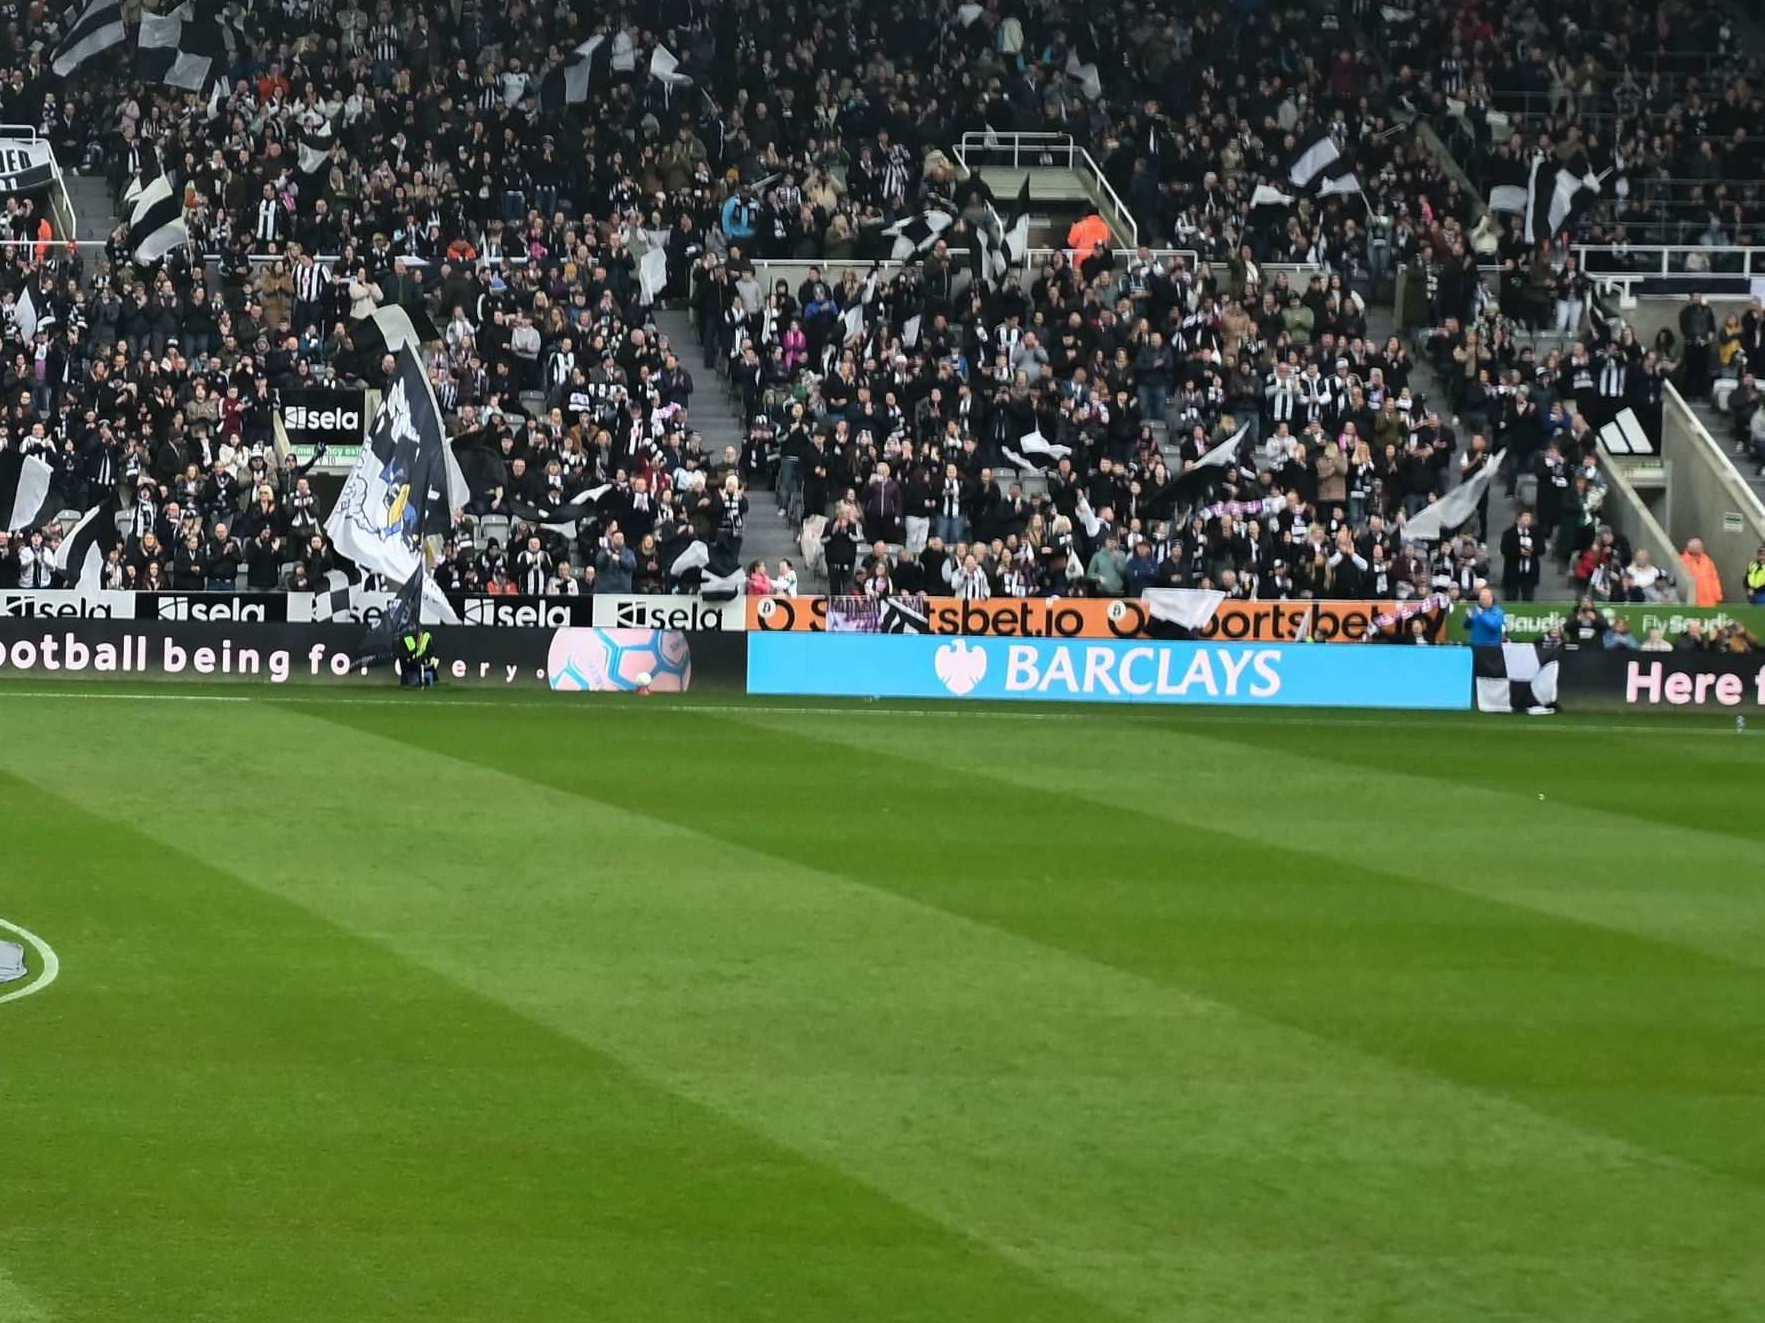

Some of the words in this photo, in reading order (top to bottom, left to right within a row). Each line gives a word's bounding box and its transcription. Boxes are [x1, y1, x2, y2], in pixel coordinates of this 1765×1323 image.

[307, 407, 359, 430] sela
[191, 597, 265, 622] sela
[497, 599, 571, 627] sela
[651, 600, 723, 631] sela
[164, 638, 290, 682] being
[1005, 648, 1282, 698] BARCLAYS
[1626, 660, 1743, 706] Here
